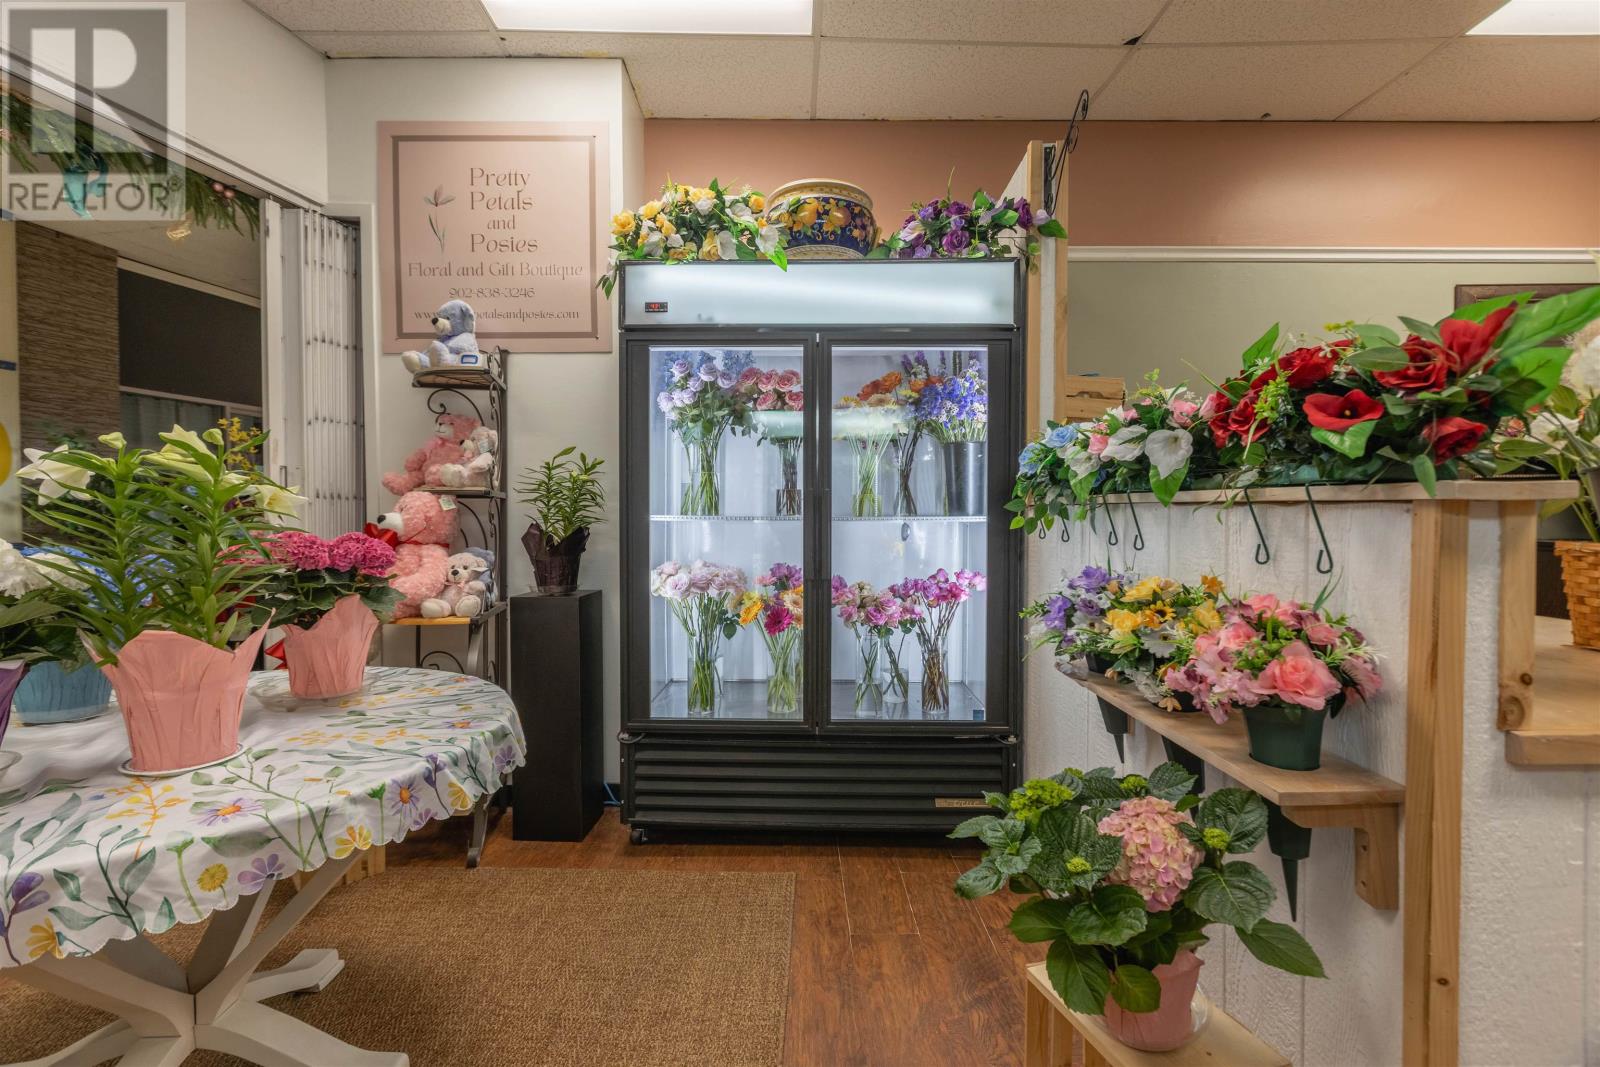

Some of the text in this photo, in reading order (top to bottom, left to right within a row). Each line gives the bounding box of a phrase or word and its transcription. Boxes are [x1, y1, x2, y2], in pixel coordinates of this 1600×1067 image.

[470, 167, 530, 188] Pretty
[470, 189, 533, 211] Petals
[487, 214, 516, 230] and
[471, 233, 538, 253] Posies
[408, 262, 583, 280] Floral and Gift Boutique
[449, 287, 536, 299] 902-838-3246
